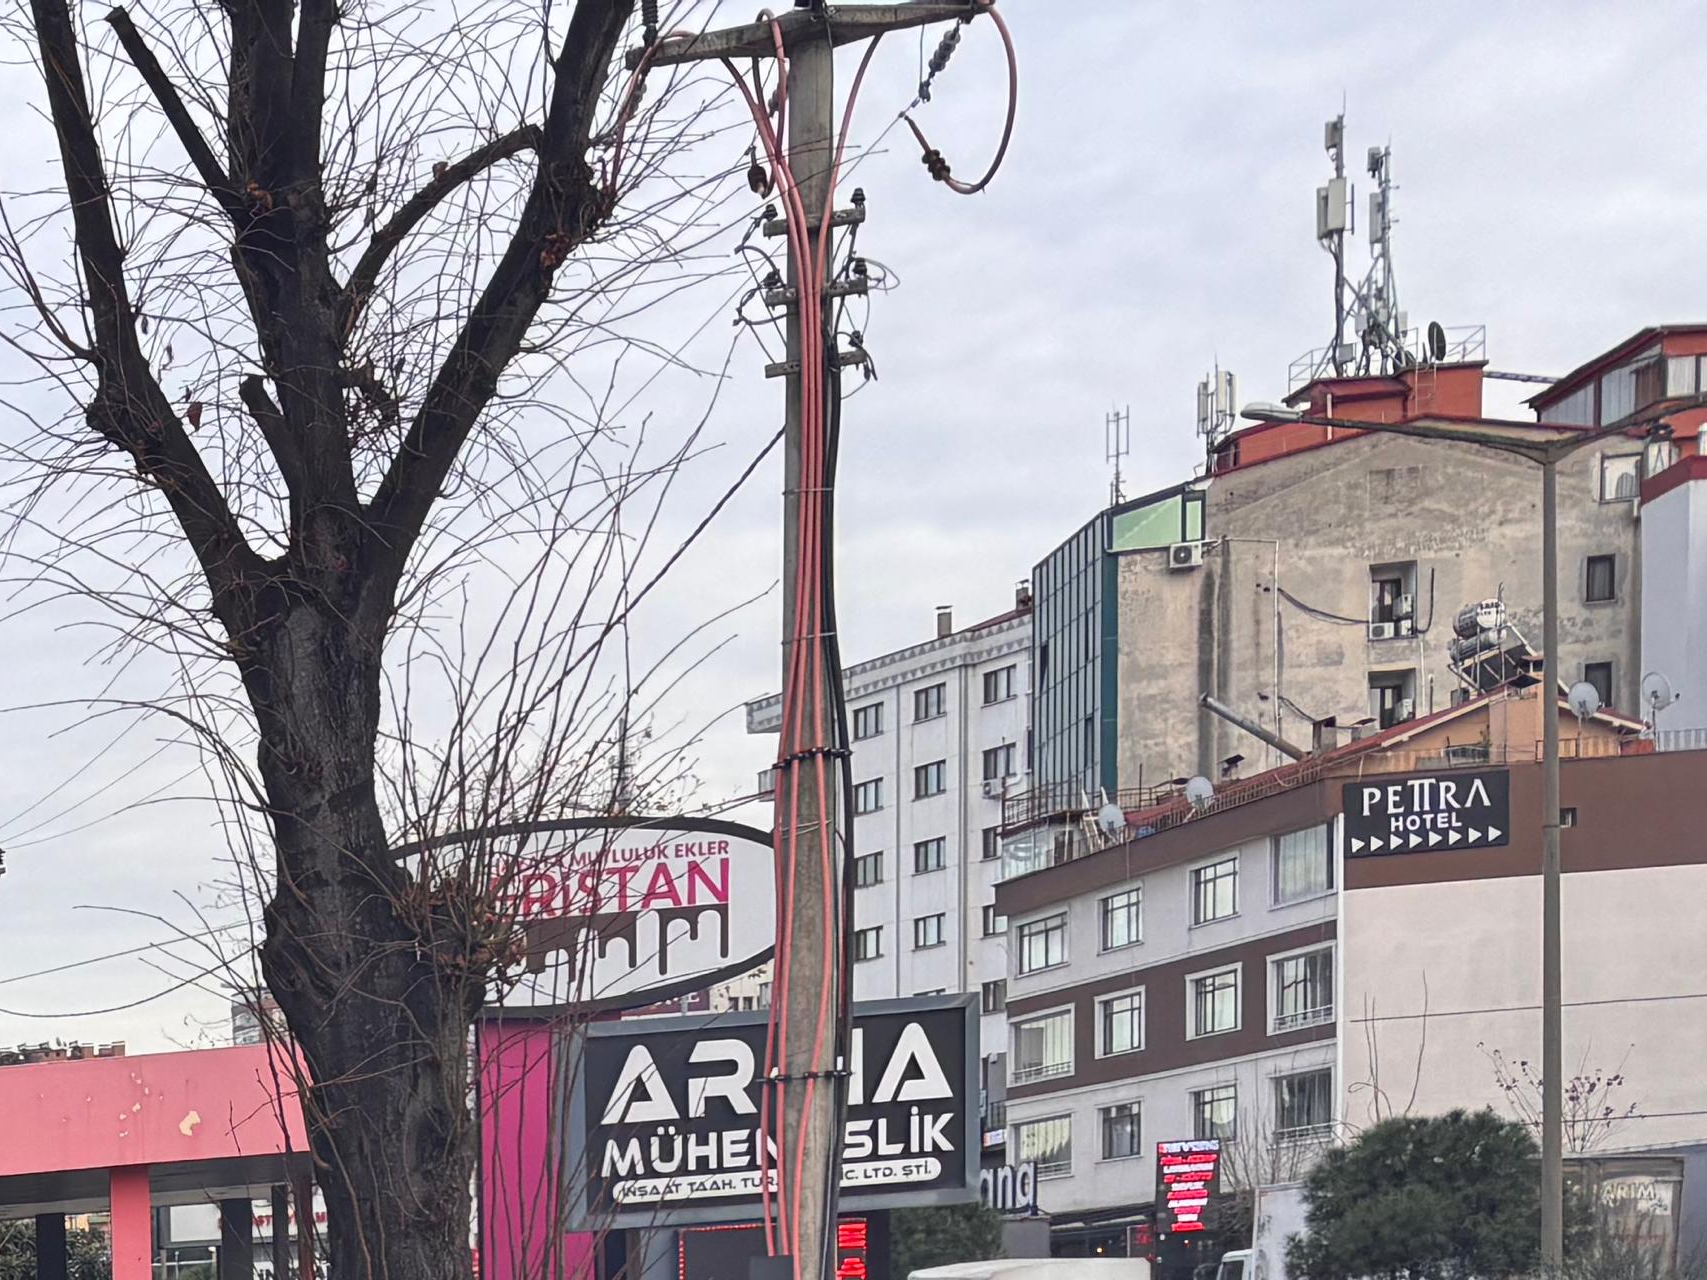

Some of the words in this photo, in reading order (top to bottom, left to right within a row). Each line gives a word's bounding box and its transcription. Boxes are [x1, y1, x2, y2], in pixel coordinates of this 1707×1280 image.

[1391, 812, 1463, 832] HOTEL
[674, 840, 730, 859] EKLER
[863, 1166, 898, 1179] LTD.
